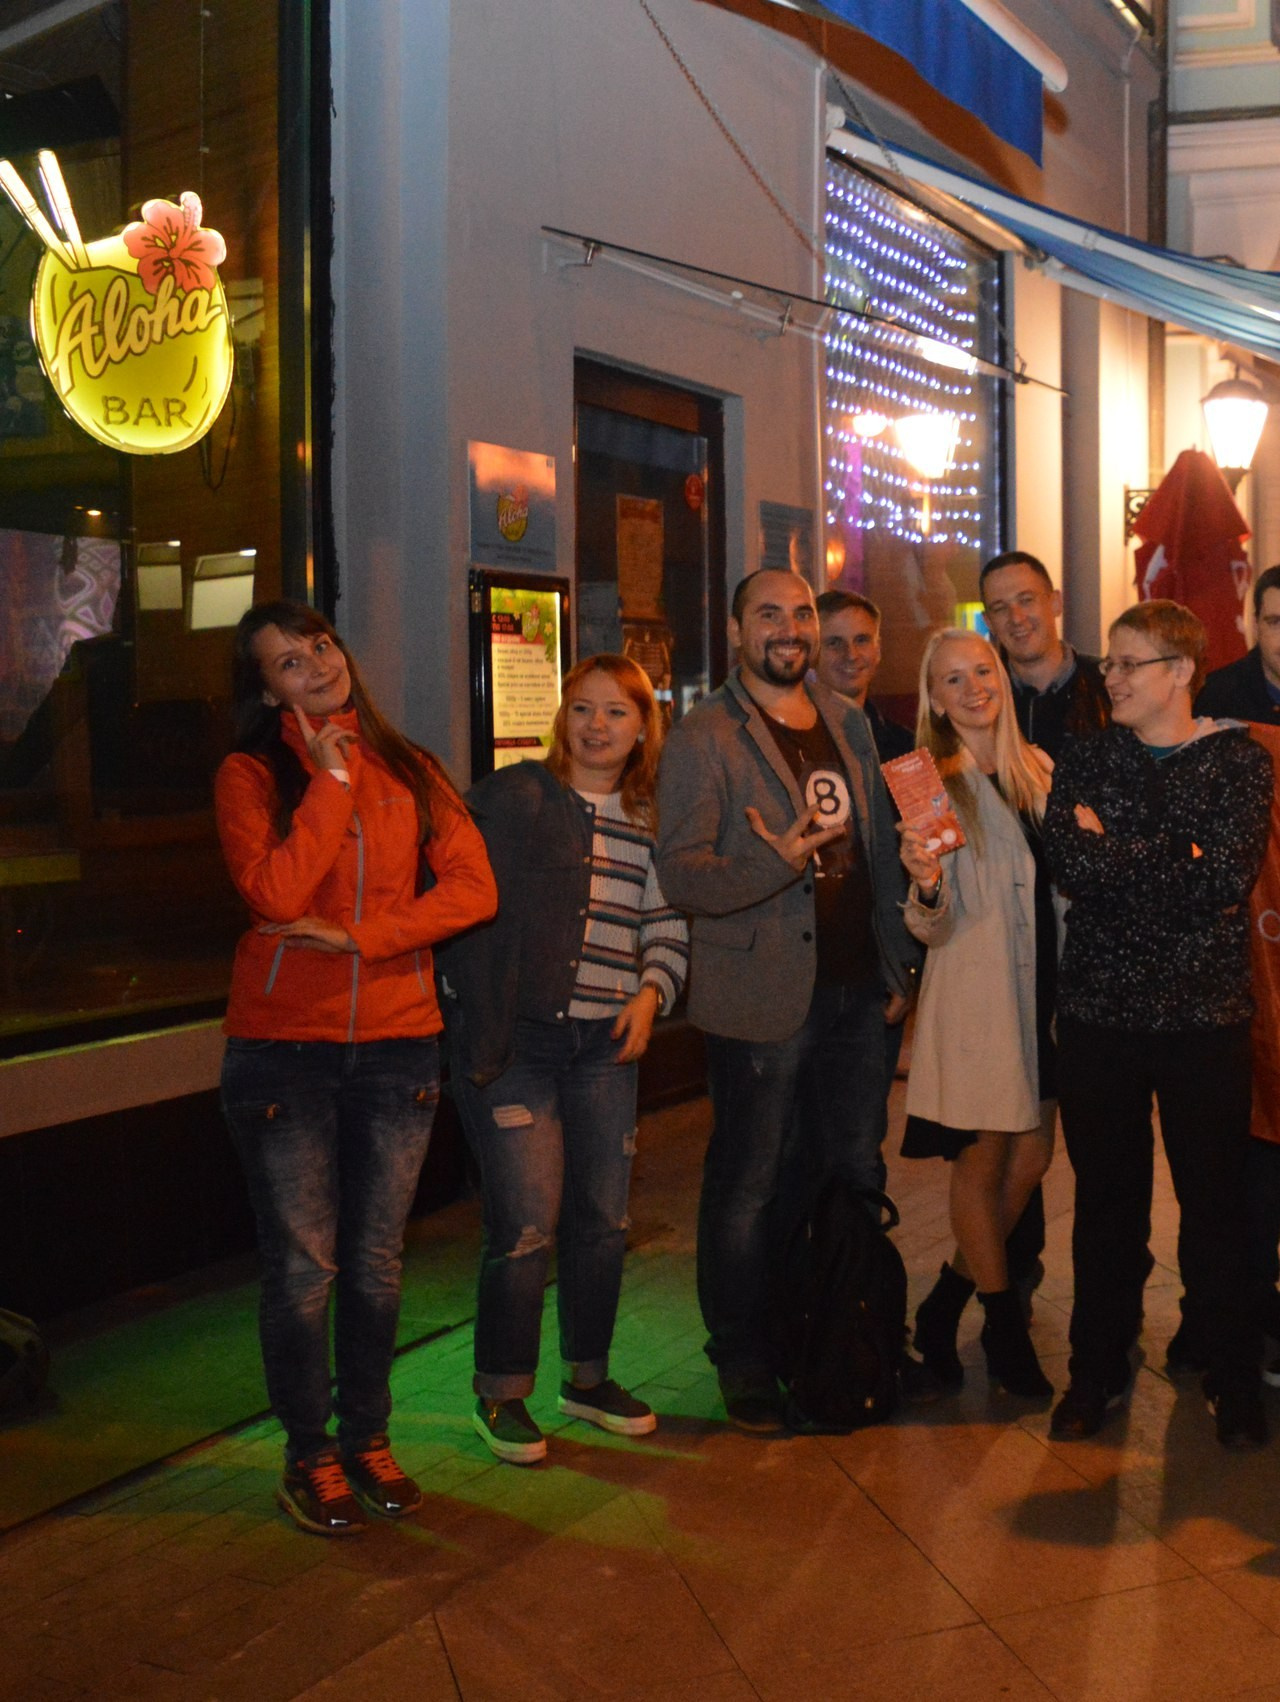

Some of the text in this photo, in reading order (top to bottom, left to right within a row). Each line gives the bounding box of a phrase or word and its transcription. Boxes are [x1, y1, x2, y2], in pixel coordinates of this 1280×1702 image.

[50, 275, 223, 396] Aloha
[101, 394, 193, 428] BAR
[813, 777, 842, 816] 8
